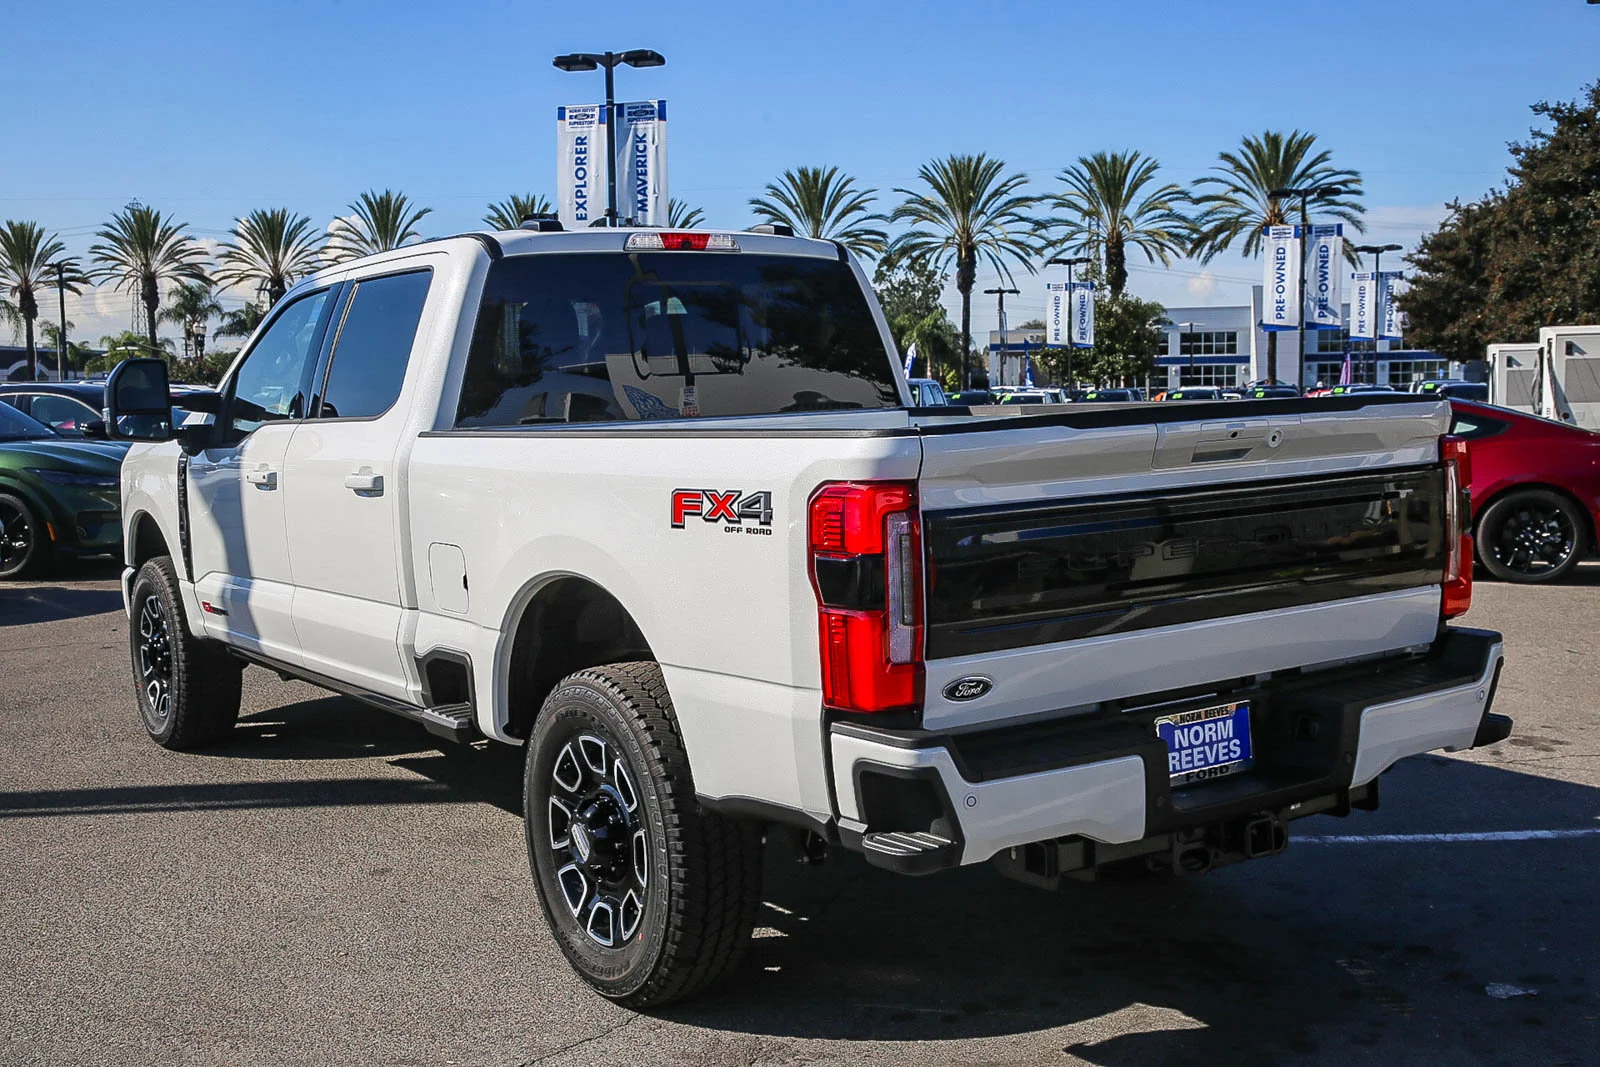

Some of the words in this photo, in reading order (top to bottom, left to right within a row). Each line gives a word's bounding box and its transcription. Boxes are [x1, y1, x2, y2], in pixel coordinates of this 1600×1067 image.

[575, 136, 587, 220] EXPLORER
[635, 133, 648, 212] MAVERICK
[1275, 246, 1286, 320] PRE-OWNED
[1318, 244, 1329, 318] PRE-OWNED
[671, 488, 773, 530] FX4
[724, 526, 743, 534] OFF
[746, 527, 772, 536] ROAD
[955, 681, 984, 697] Ford
[1180, 709, 1202, 723] NORM
[1204, 705, 1229, 719] REEVES
[1174, 719, 1234, 749] NORM
[1167, 738, 1241, 772] REEVES
[1185, 764, 1230, 781] FORD
